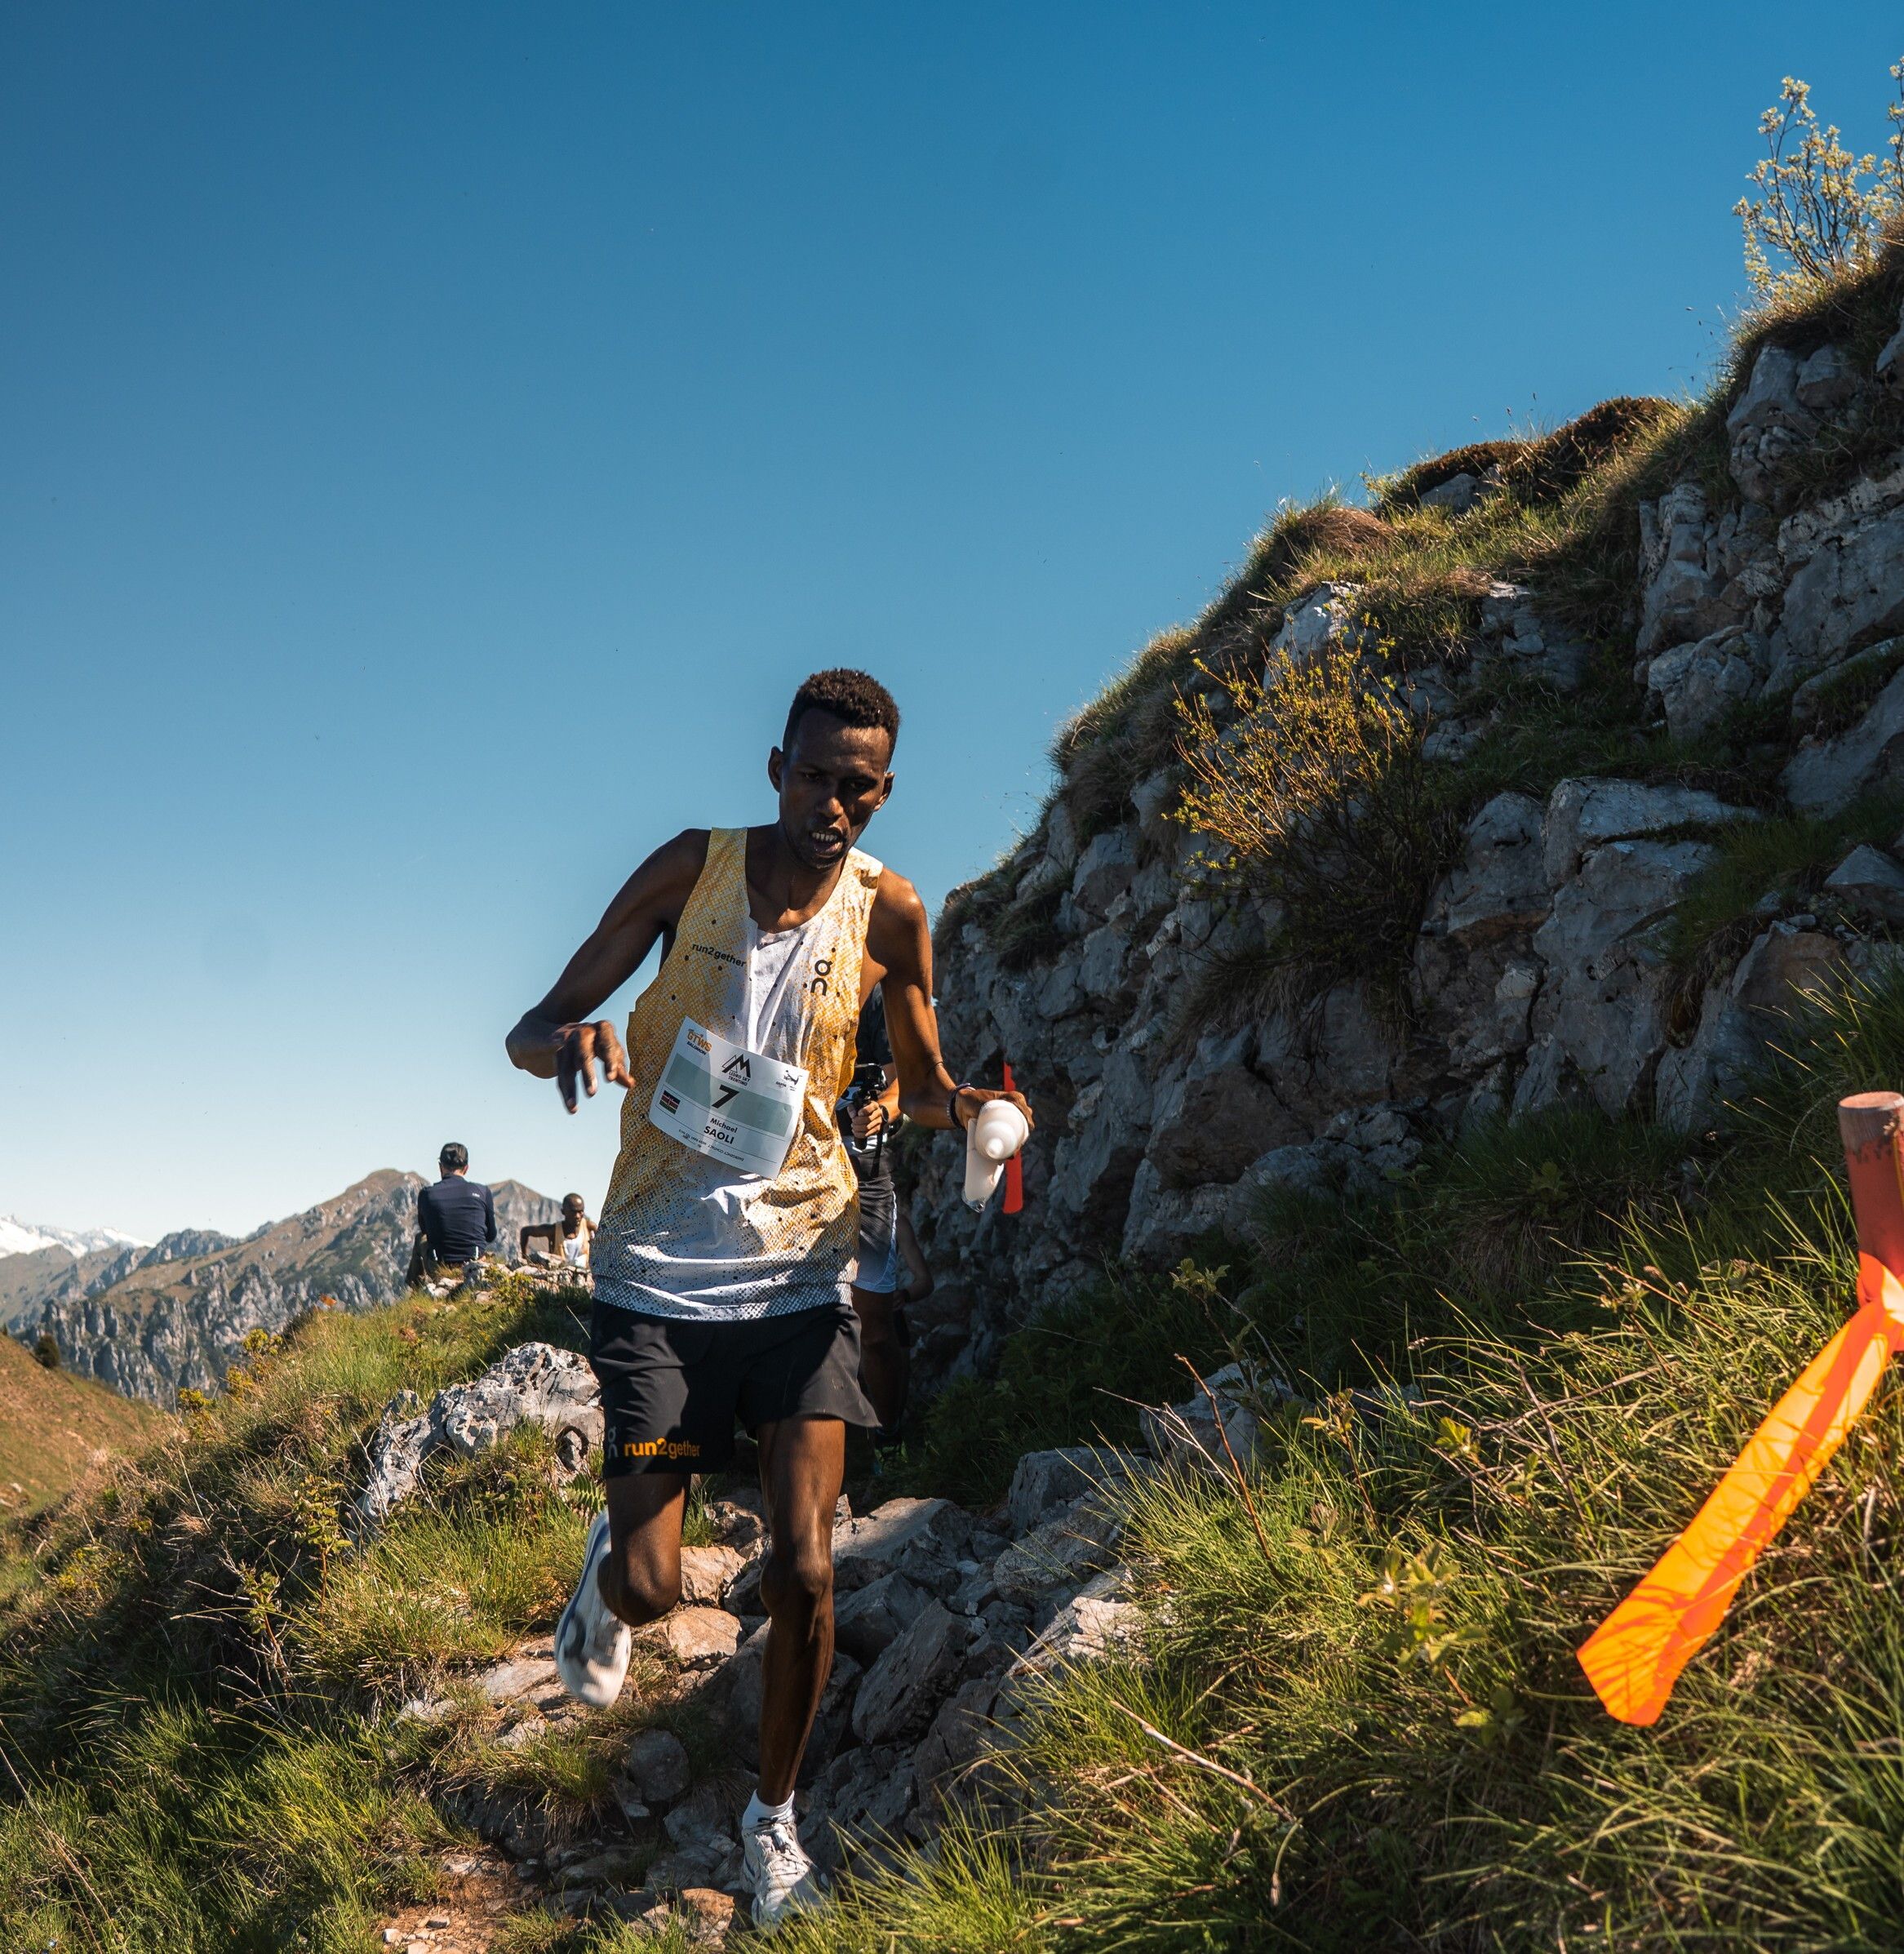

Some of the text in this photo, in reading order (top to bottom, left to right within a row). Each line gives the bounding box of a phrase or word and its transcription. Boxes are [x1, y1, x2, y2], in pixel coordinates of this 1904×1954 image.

[692, 944, 746, 968] run2gether
[687, 1031, 712, 1052] GTWS
[728, 1076, 748, 1086] TRENTINO
[729, 1071, 742, 1079] LEDRO
[712, 1084, 740, 1109] 7
[703, 1126, 735, 1144] SAOLI
[710, 1117, 739, 1134] Michael
[624, 1437, 701, 1459] run2gether
